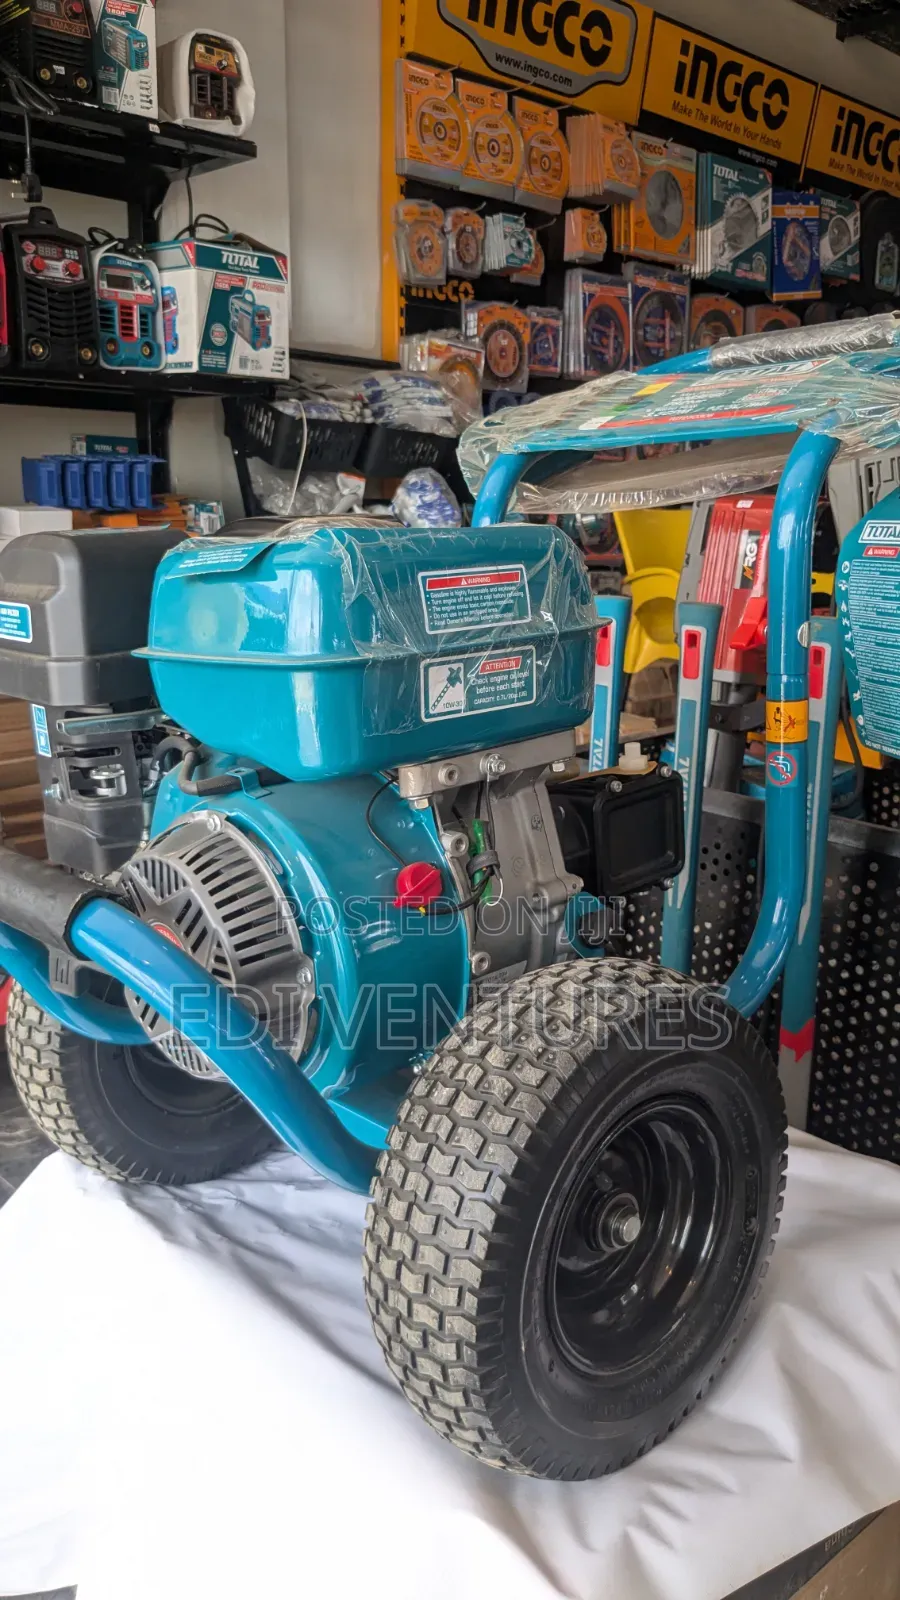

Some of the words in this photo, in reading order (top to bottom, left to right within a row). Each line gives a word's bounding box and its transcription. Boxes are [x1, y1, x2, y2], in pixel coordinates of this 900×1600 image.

[494, 51, 573, 88] www.ingco.com
[671, 99, 693, 118] Make
[695, 108, 710, 124] The
[710, 115, 733, 132] World
[742, 127, 761, 140] Your
[759, 132, 782, 150] Hands
[831, 105, 900, 174] INGC
[713, 164, 740, 182] TOTAL
[221, 250, 260, 269] TOTAL
[874, 548, 896, 556] WARNING
[442, 598, 457, 606] engine
[485, 660, 516, 671] ATTENTION
[489, 674, 508, 684] engine
[516, 670, 530, 678] level
[476, 686, 495, 695] before
[496, 684, 510, 692] each
[510, 681, 525, 689] start
